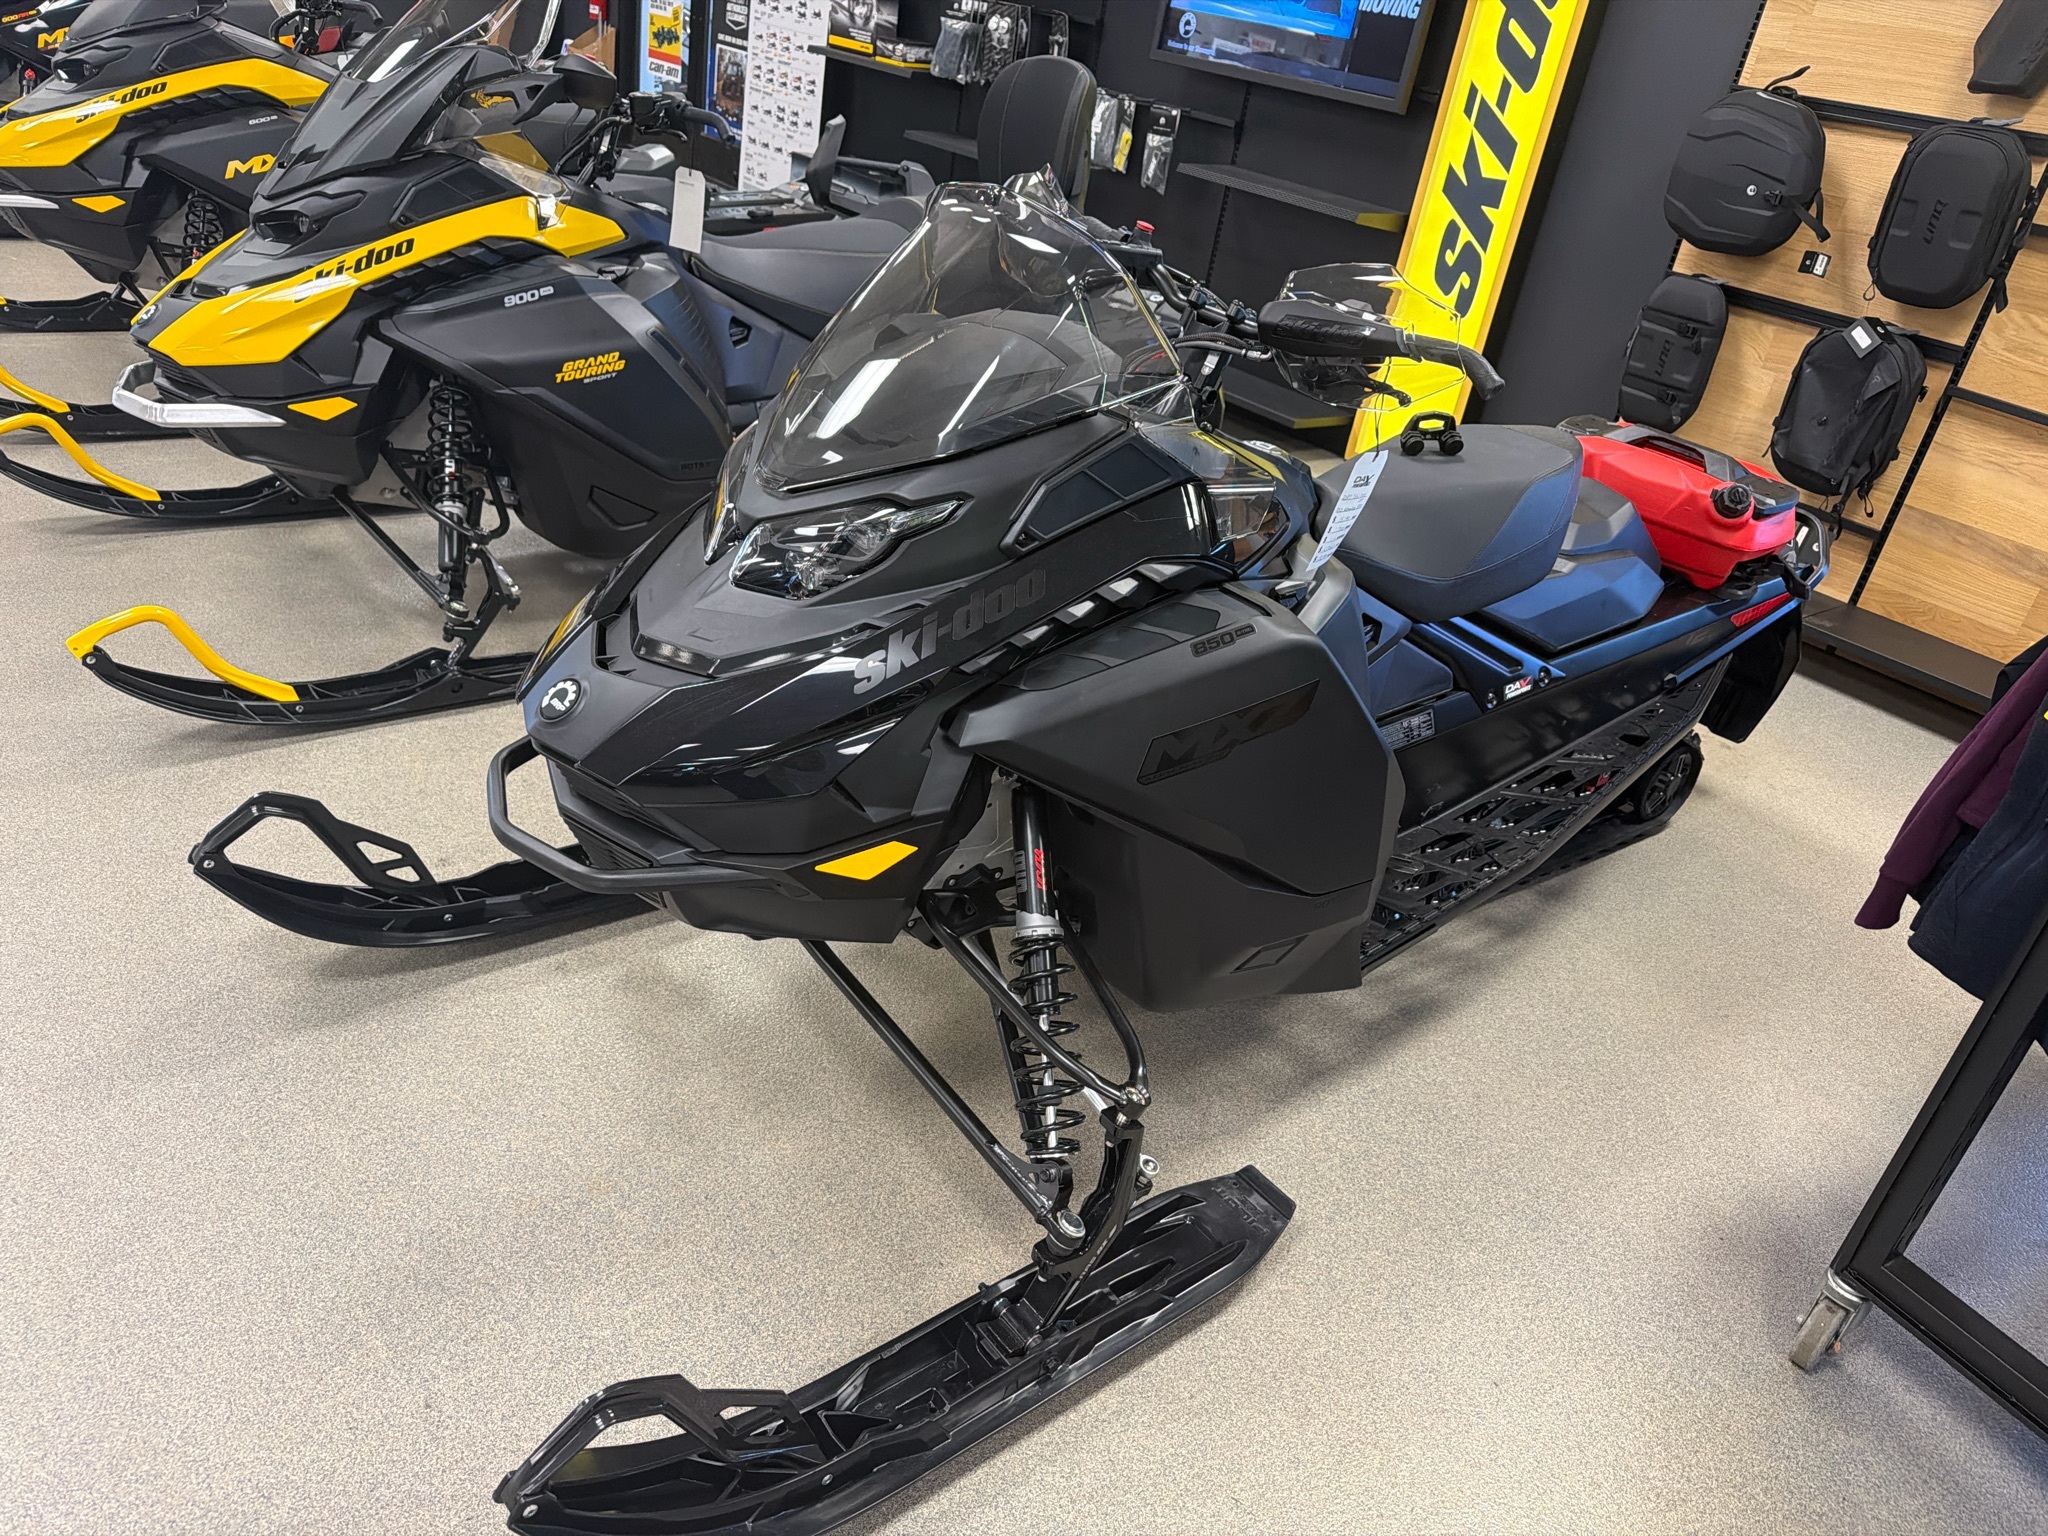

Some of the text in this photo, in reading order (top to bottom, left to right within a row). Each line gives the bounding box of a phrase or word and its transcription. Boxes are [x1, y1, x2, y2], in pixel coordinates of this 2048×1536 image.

[1358, 0, 1421, 19] MOVING
[649, 61, 680, 79] can-am
[1435, 0, 1559, 318] ski-d
[294, 238, 415, 303] ski-doo
[504, 289, 539, 307] 900
[555, 359, 627, 384] TOURING
[562, 351, 620, 372] GRAND
[583, 372, 618, 384] SPORT
[854, 569, 1047, 695] ski-doo
[1193, 631, 1235, 656] 850
